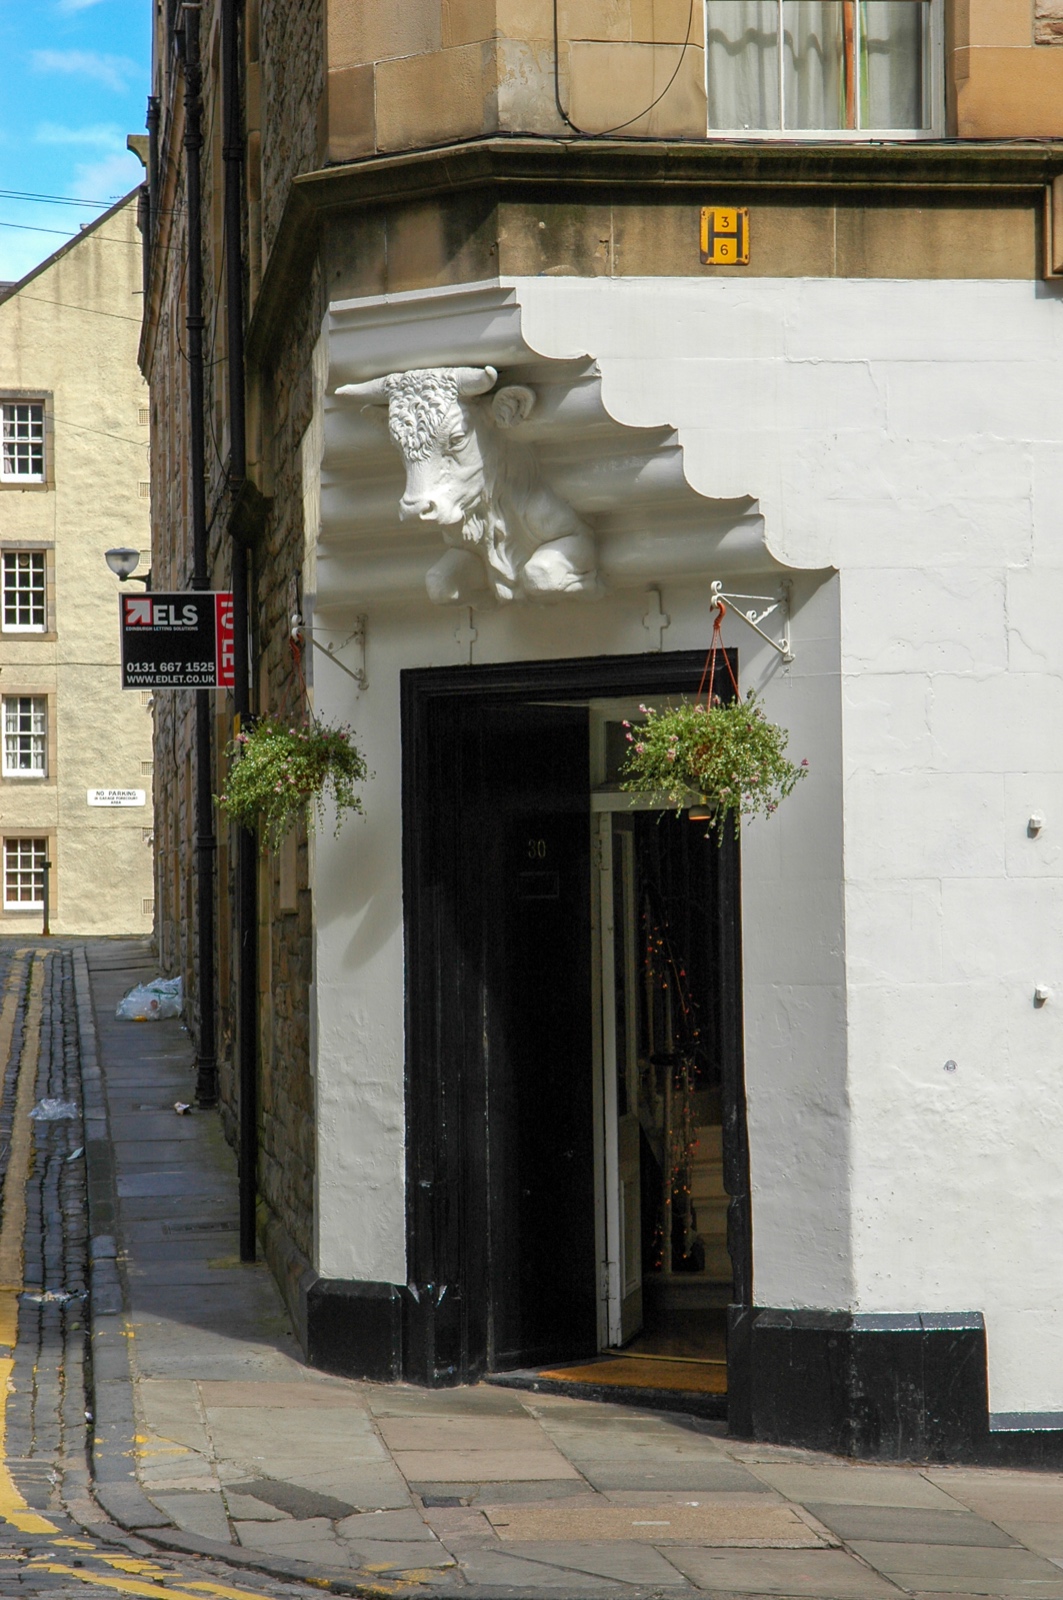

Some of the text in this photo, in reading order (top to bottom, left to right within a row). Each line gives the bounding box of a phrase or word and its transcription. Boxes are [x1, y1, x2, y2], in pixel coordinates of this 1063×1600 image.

[721, 216, 730, 228] 3
[708, 212, 743, 258] H
[720, 244, 729, 256] 6
[153, 605, 198, 625] ELS
[126, 662, 215, 672] 0131 667 1525
[126, 675, 215, 683] WWW.EDLET.CO.UK
[528, 840, 546, 858] 30
